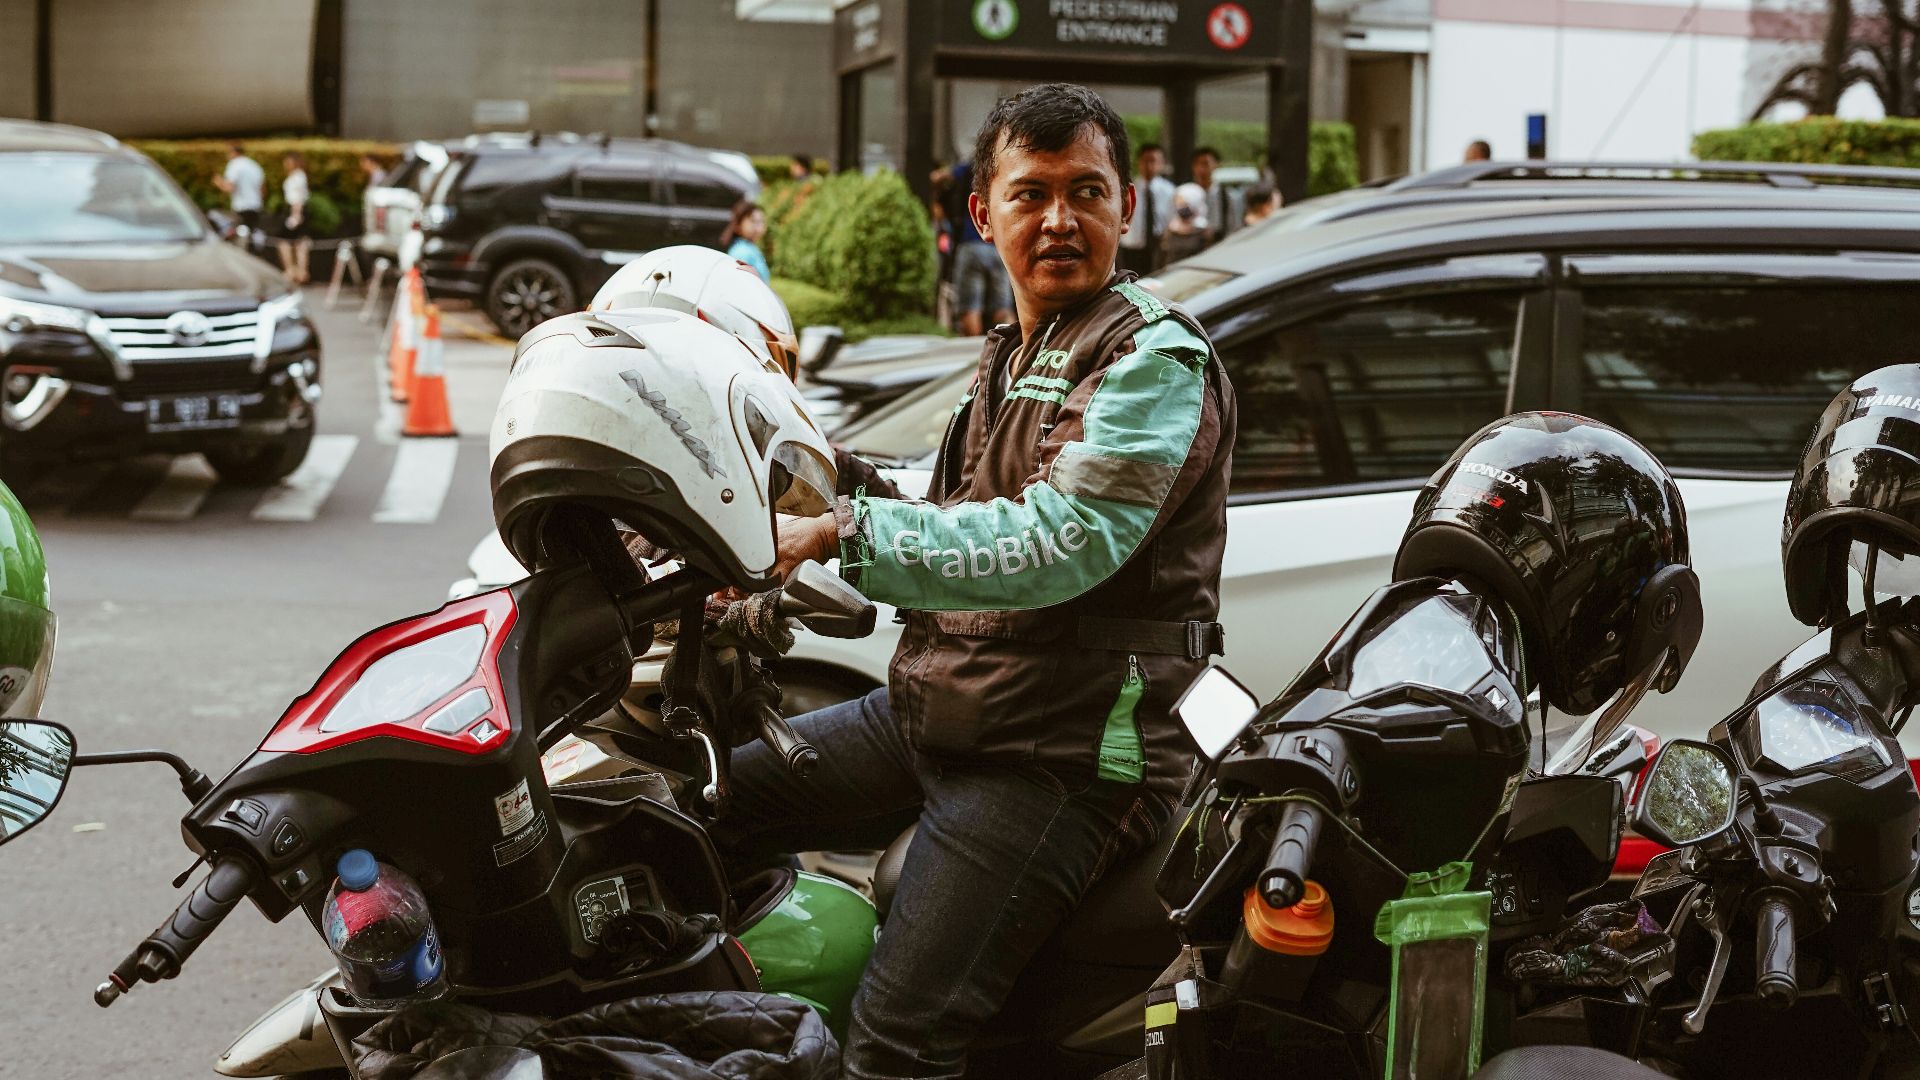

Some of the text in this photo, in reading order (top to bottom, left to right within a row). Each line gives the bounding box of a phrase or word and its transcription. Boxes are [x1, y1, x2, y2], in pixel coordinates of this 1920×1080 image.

[1049, 0, 1178, 22] PEDESTRIAN
[1056, 20, 1168, 46] ENTRANCE
[1457, 462, 1528, 495] HONDA
[894, 522, 1088, 578] GrabBike
